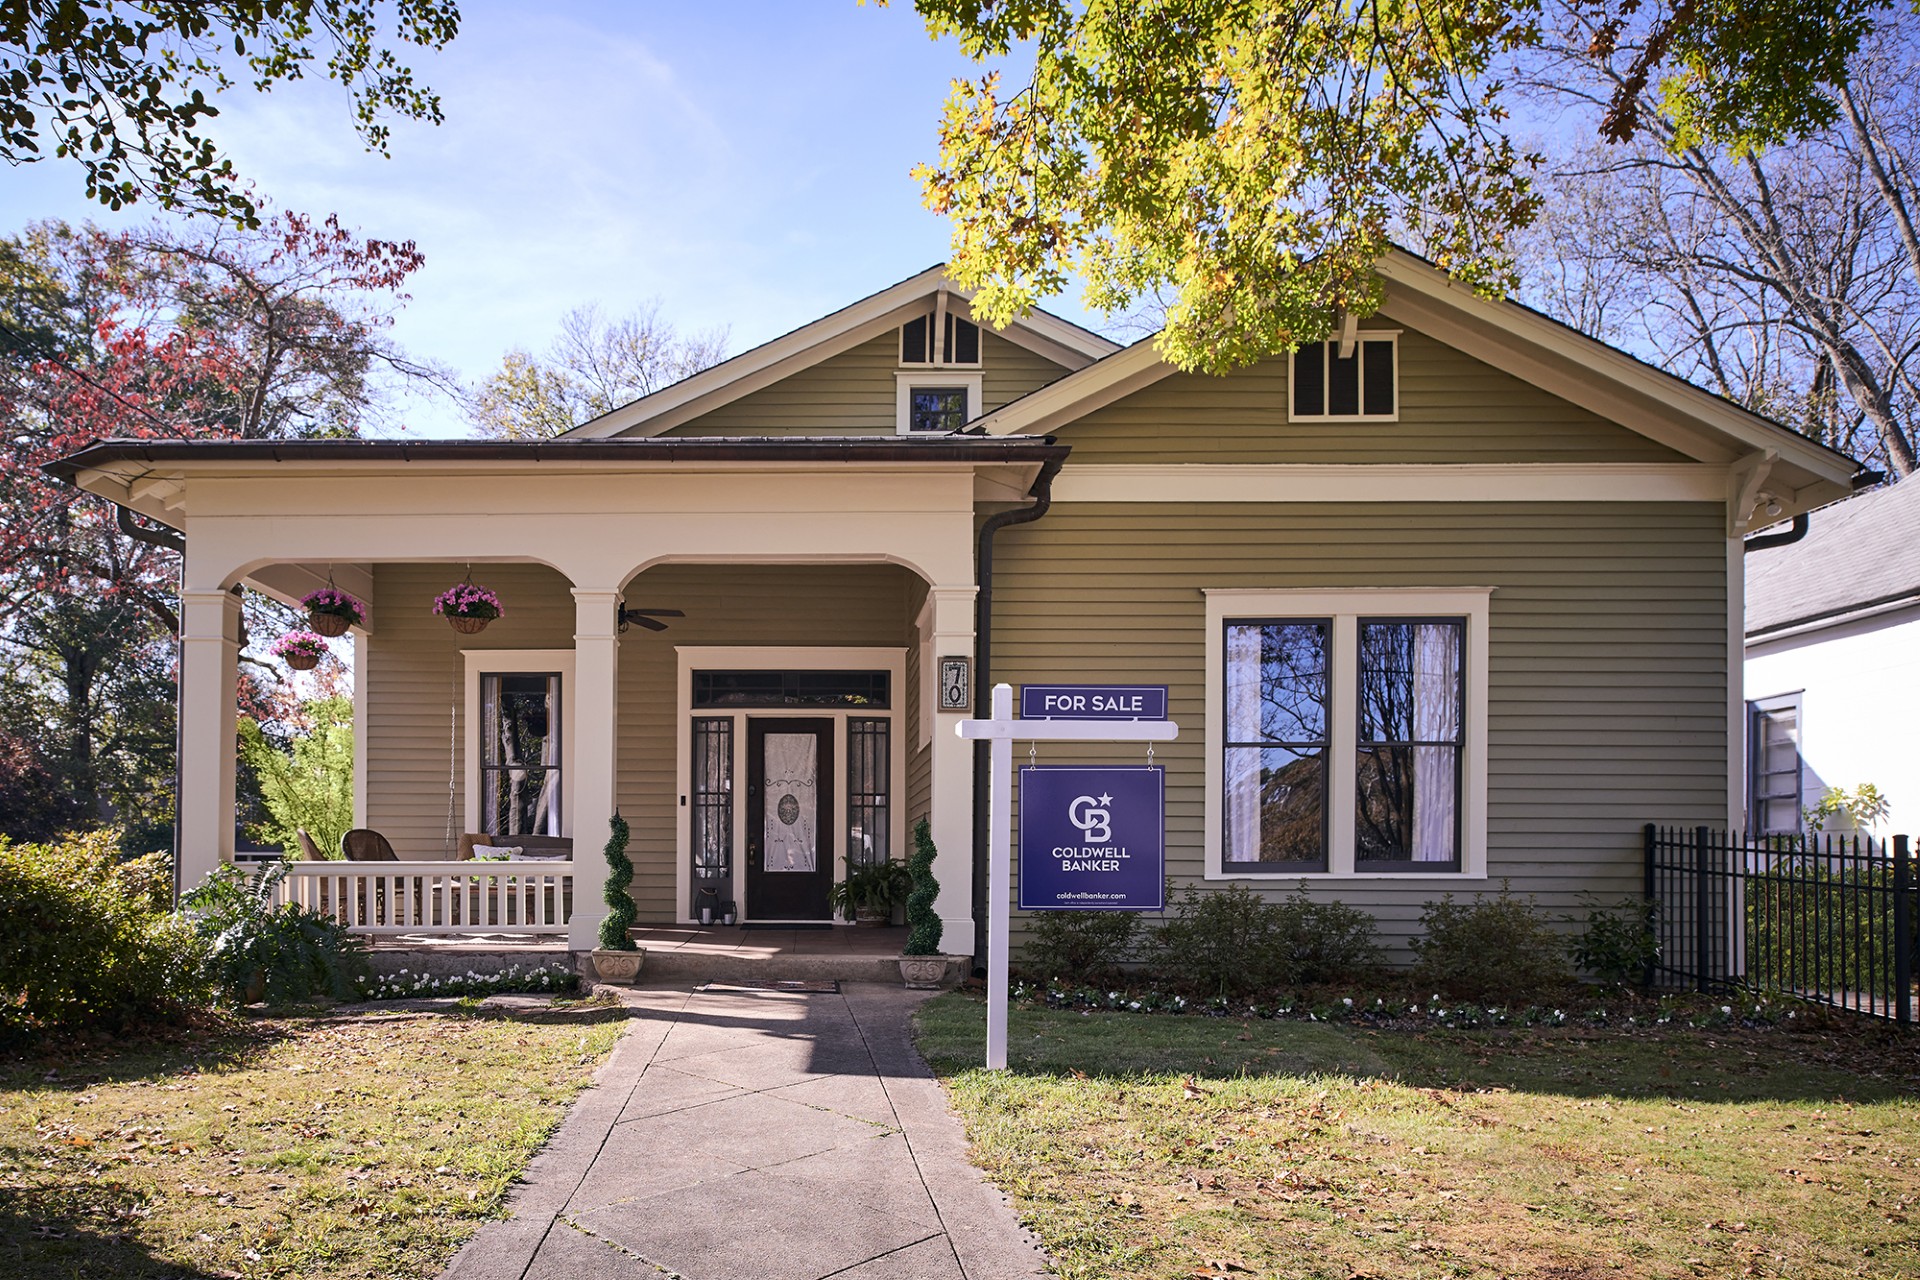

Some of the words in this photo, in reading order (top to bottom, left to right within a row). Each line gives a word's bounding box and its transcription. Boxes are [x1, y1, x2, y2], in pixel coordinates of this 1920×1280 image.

[948, 666, 962, 703] 70
[1045, 695, 1086, 711] FOR
[1092, 695, 1143, 711] SALE
[1068, 795, 1112, 843] CB
[1052, 847, 1130, 858] COLDWELL
[1062, 860, 1119, 871] BANKER
[1056, 892, 1126, 900] coldwellbanker.com
